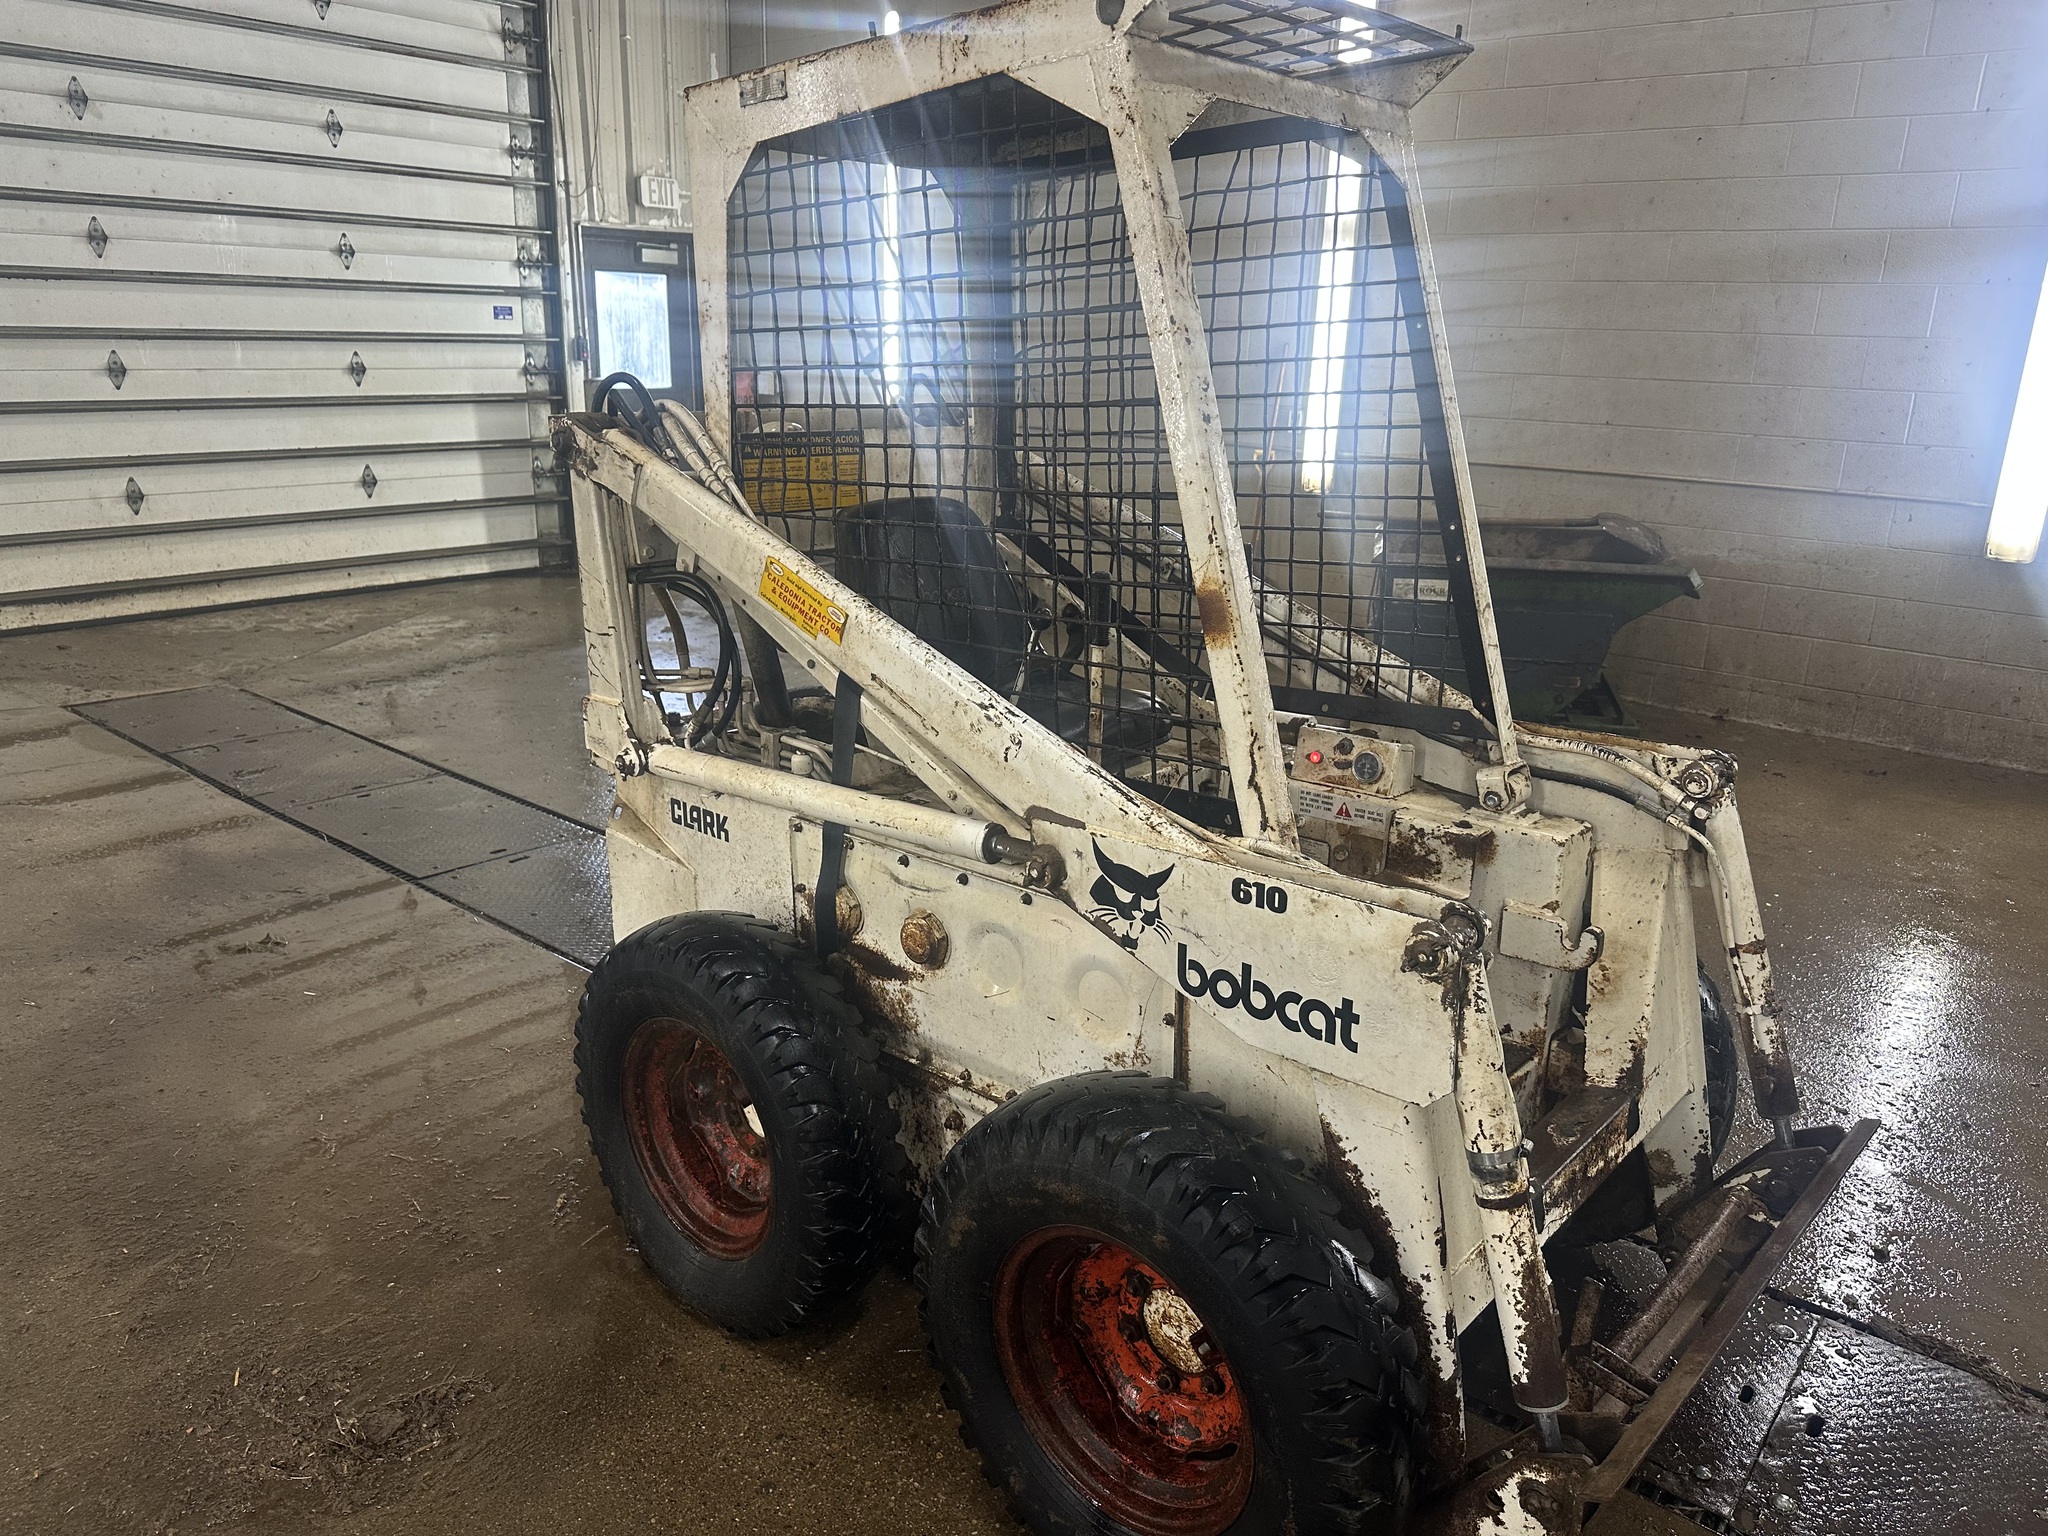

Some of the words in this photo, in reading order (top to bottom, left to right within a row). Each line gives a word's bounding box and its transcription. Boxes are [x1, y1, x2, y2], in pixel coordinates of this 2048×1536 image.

[647, 177, 674, 206] EXIT
[767, 573, 806, 607] CALEDONIA
[807, 604, 841, 634] TRACTOR
[771, 588, 777, 596] &
[778, 591, 819, 627] EQUIPMENT
[819, 624, 831, 638] CO.
[670, 797, 729, 843] CLARK
[1231, 877, 1288, 914] 610
[1177, 942, 1360, 1054] bobcat
